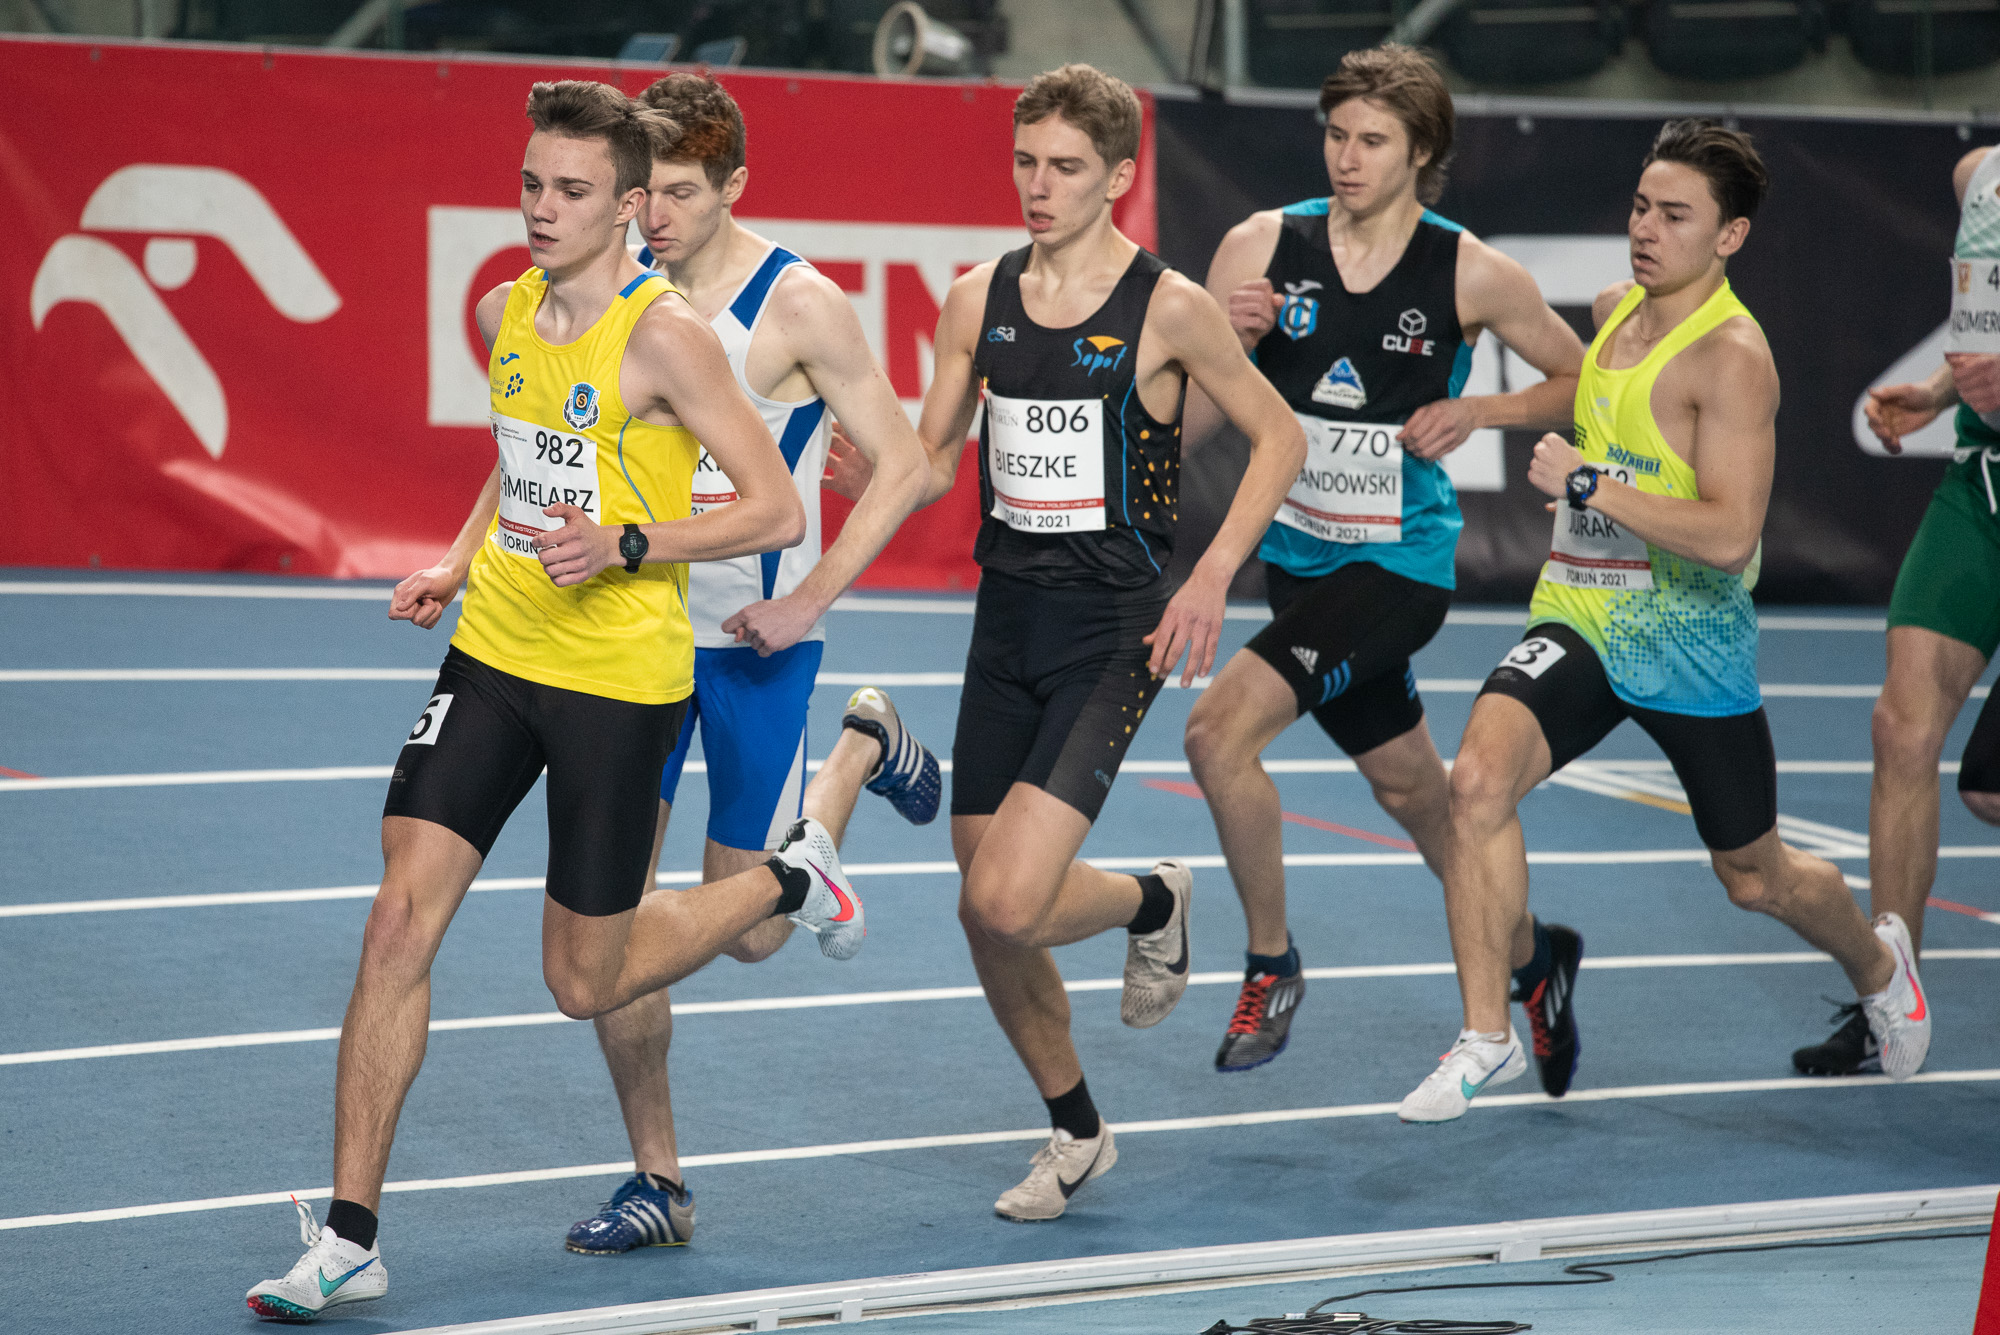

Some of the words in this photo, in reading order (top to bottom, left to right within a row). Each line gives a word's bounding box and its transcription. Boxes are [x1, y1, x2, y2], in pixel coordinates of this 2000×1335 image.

[1071, 338, 1128, 376] Sopot
[1026, 404, 1089, 433] 806
[535, 430, 584, 468] 982
[1327, 428, 1390, 457] 770
[995, 449, 1077, 478] BIESZKE
[501, 467, 594, 513] HMIELARZ
[1299, 467, 1396, 495] ANDOWSKI
[1036, 515, 1071, 528] 2021
[1336, 525, 1368, 541] 2021
[1569, 510, 1619, 538] JURAK
[1600, 573, 1627, 586] 2021
[1509, 640, 1548, 665] 3
